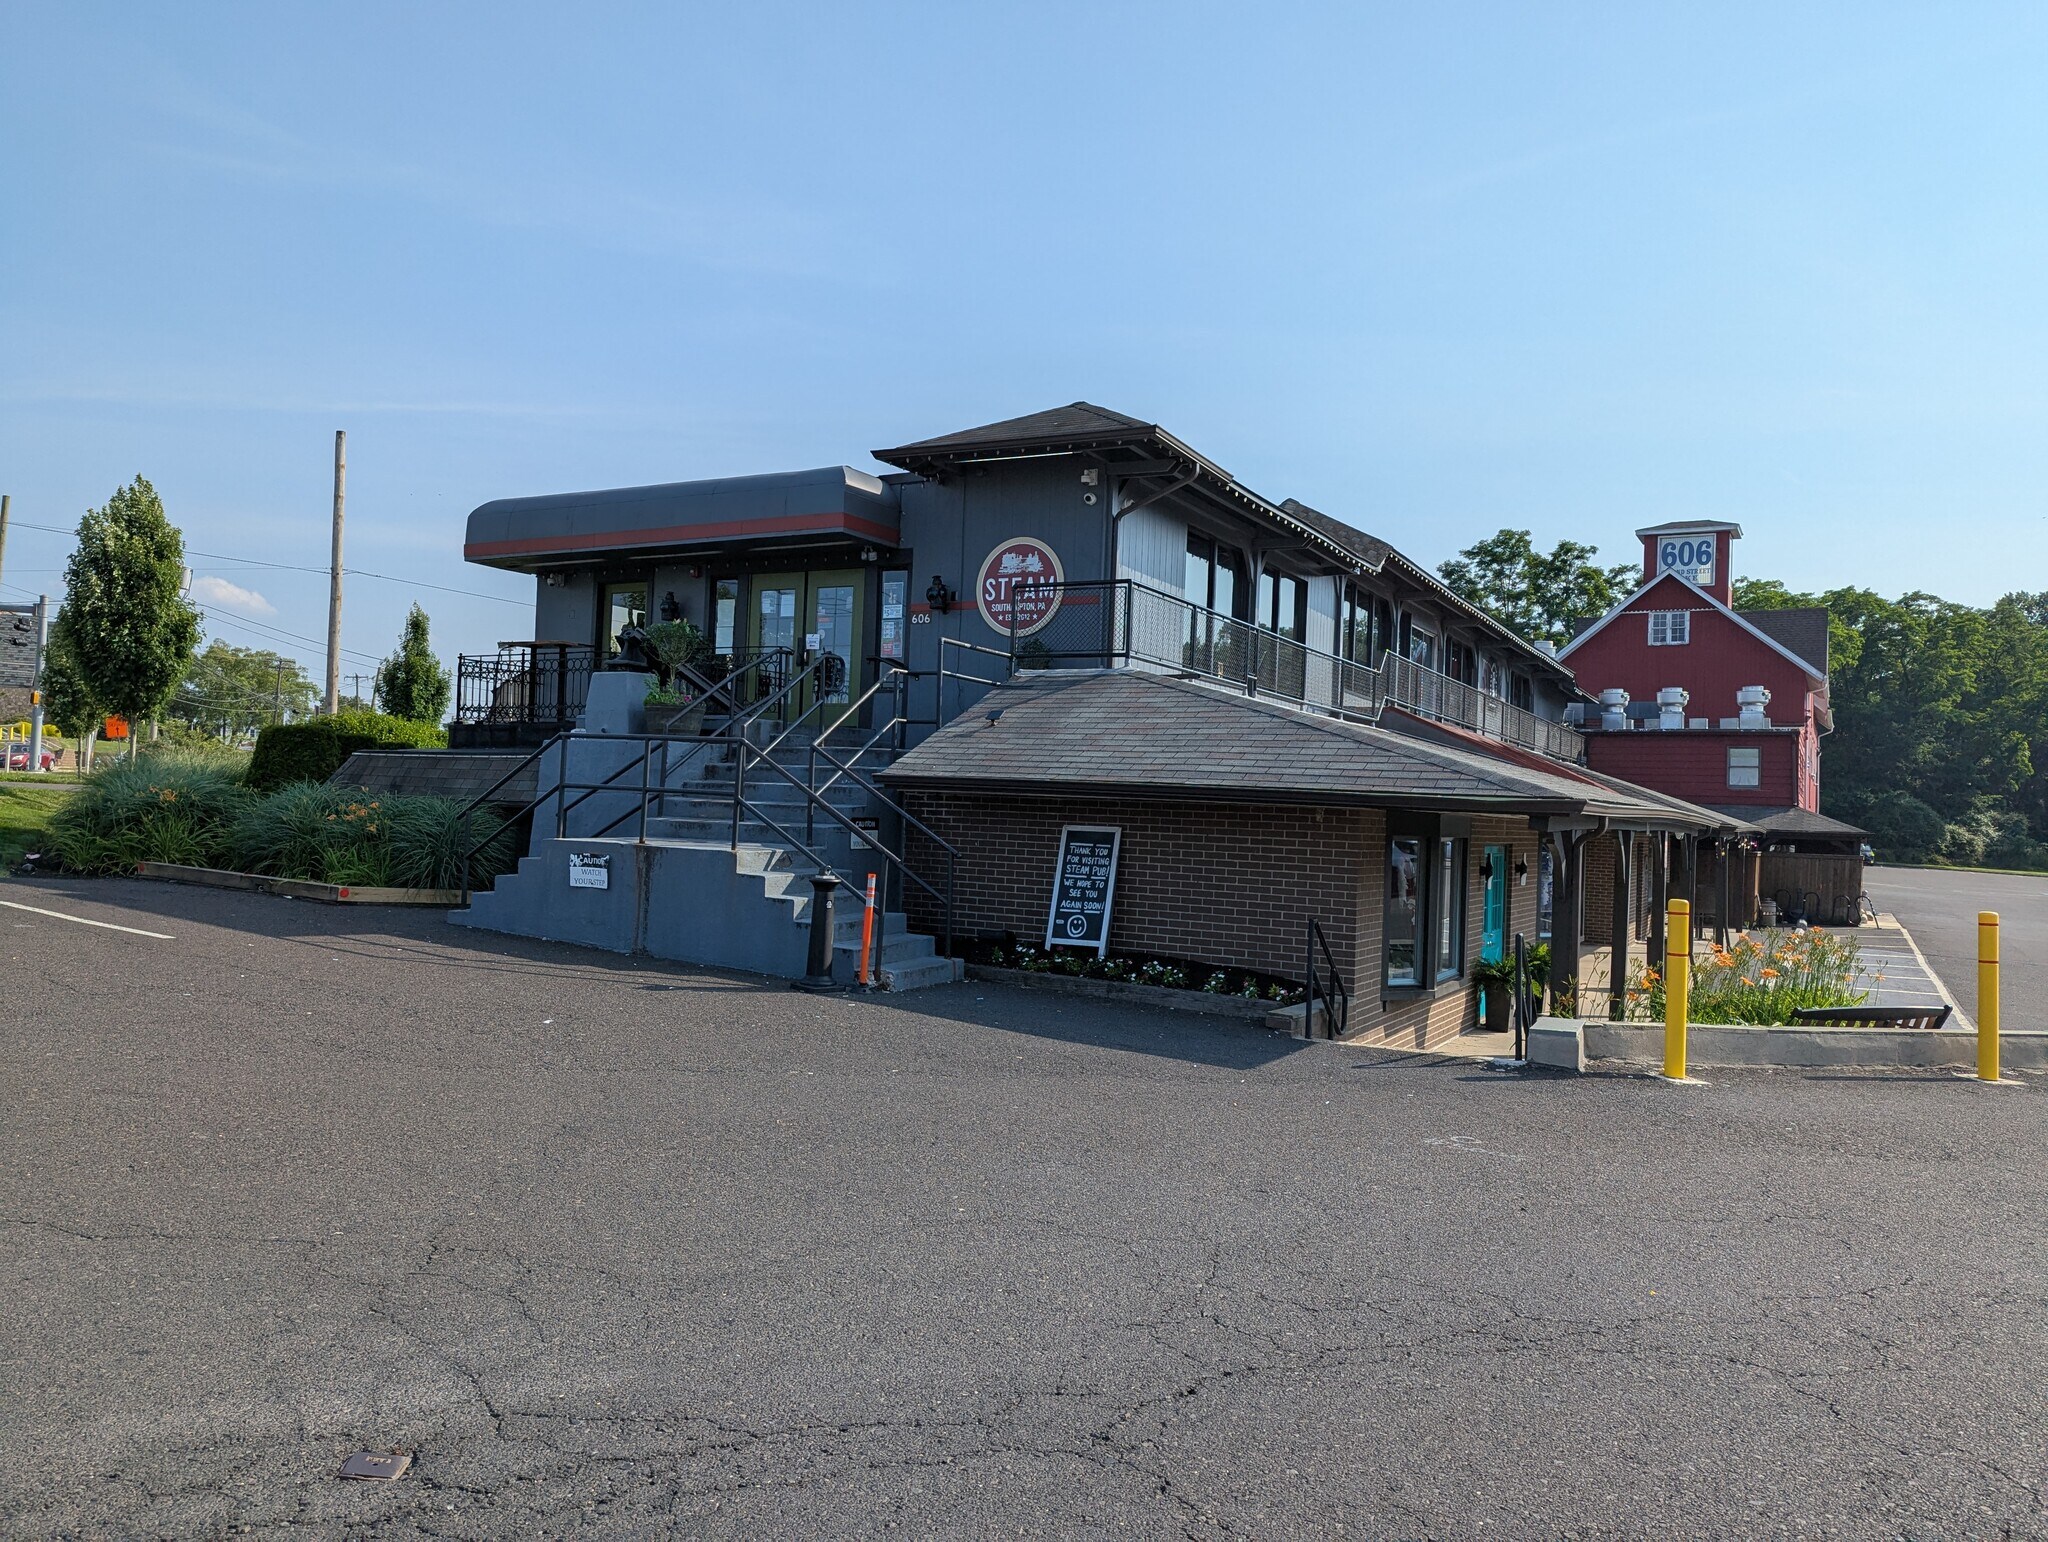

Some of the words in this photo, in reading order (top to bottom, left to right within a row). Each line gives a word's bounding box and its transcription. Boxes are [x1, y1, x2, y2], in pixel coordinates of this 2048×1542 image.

[1661, 540, 1712, 566] 606
[991, 603, 1036, 611] SOUTHPTON,
[911, 614, 931, 624] 606
[1069, 846, 1091, 855] THANK
[1094, 847, 1109, 856] YOU
[1066, 855, 1079, 864] FOR
[1081, 856, 1110, 866] VISITING
[581, 868, 602, 876] WATCH
[1066, 864, 1089, 875] STEAM
[1091, 865, 1110, 877] PUB!
[1063, 878, 1074, 887] WE
[1076, 879, 1092, 888] HOPE
[1095, 880, 1105, 889] TO
[1068, 888, 1082, 897] SEE
[1085, 889, 1098, 898] YOU
[1060, 899, 1082, 909] AGAIN
[1083, 901, 1105, 912] SOON!
